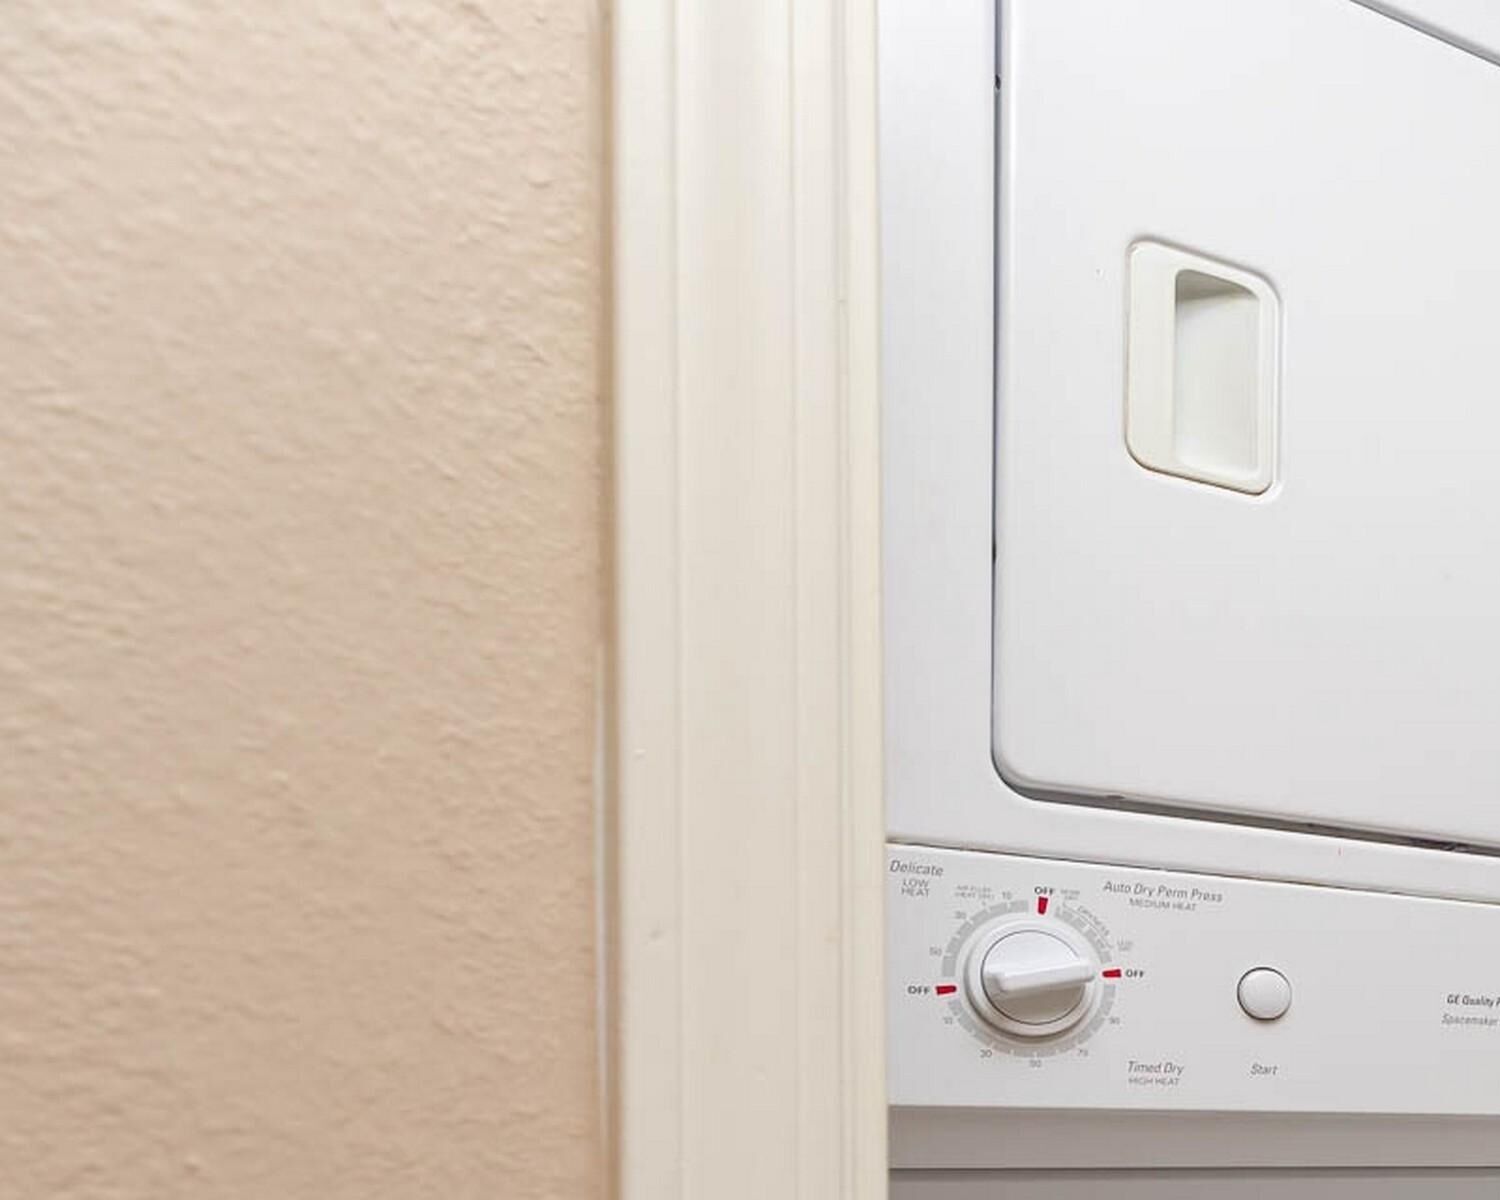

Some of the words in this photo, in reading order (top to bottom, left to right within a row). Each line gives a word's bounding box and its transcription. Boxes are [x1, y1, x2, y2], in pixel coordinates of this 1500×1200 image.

[889, 859, 943, 876] Delicate
[903, 879, 929, 888] LOW
[901, 887, 929, 898] HEAT
[1034, 887, 1056, 896] OFF
[1102, 881, 1131, 894] Auto
[1133, 882, 1155, 897] Dry
[1156, 884, 1188, 899] Perm
[1190, 888, 1223, 903] Press
[1129, 897, 1170, 909] MEDIUM
[1172, 902, 1197, 911] HEAT
[1125, 968, 1144, 978] OFF
[907, 985, 930, 995] OFF
[1128, 1061, 1162, 1074] Timed
[1163, 1062, 1184, 1076] Dry
[1250, 1063, 1278, 1076] Start
[1155, 1077, 1180, 1086] HEAT
